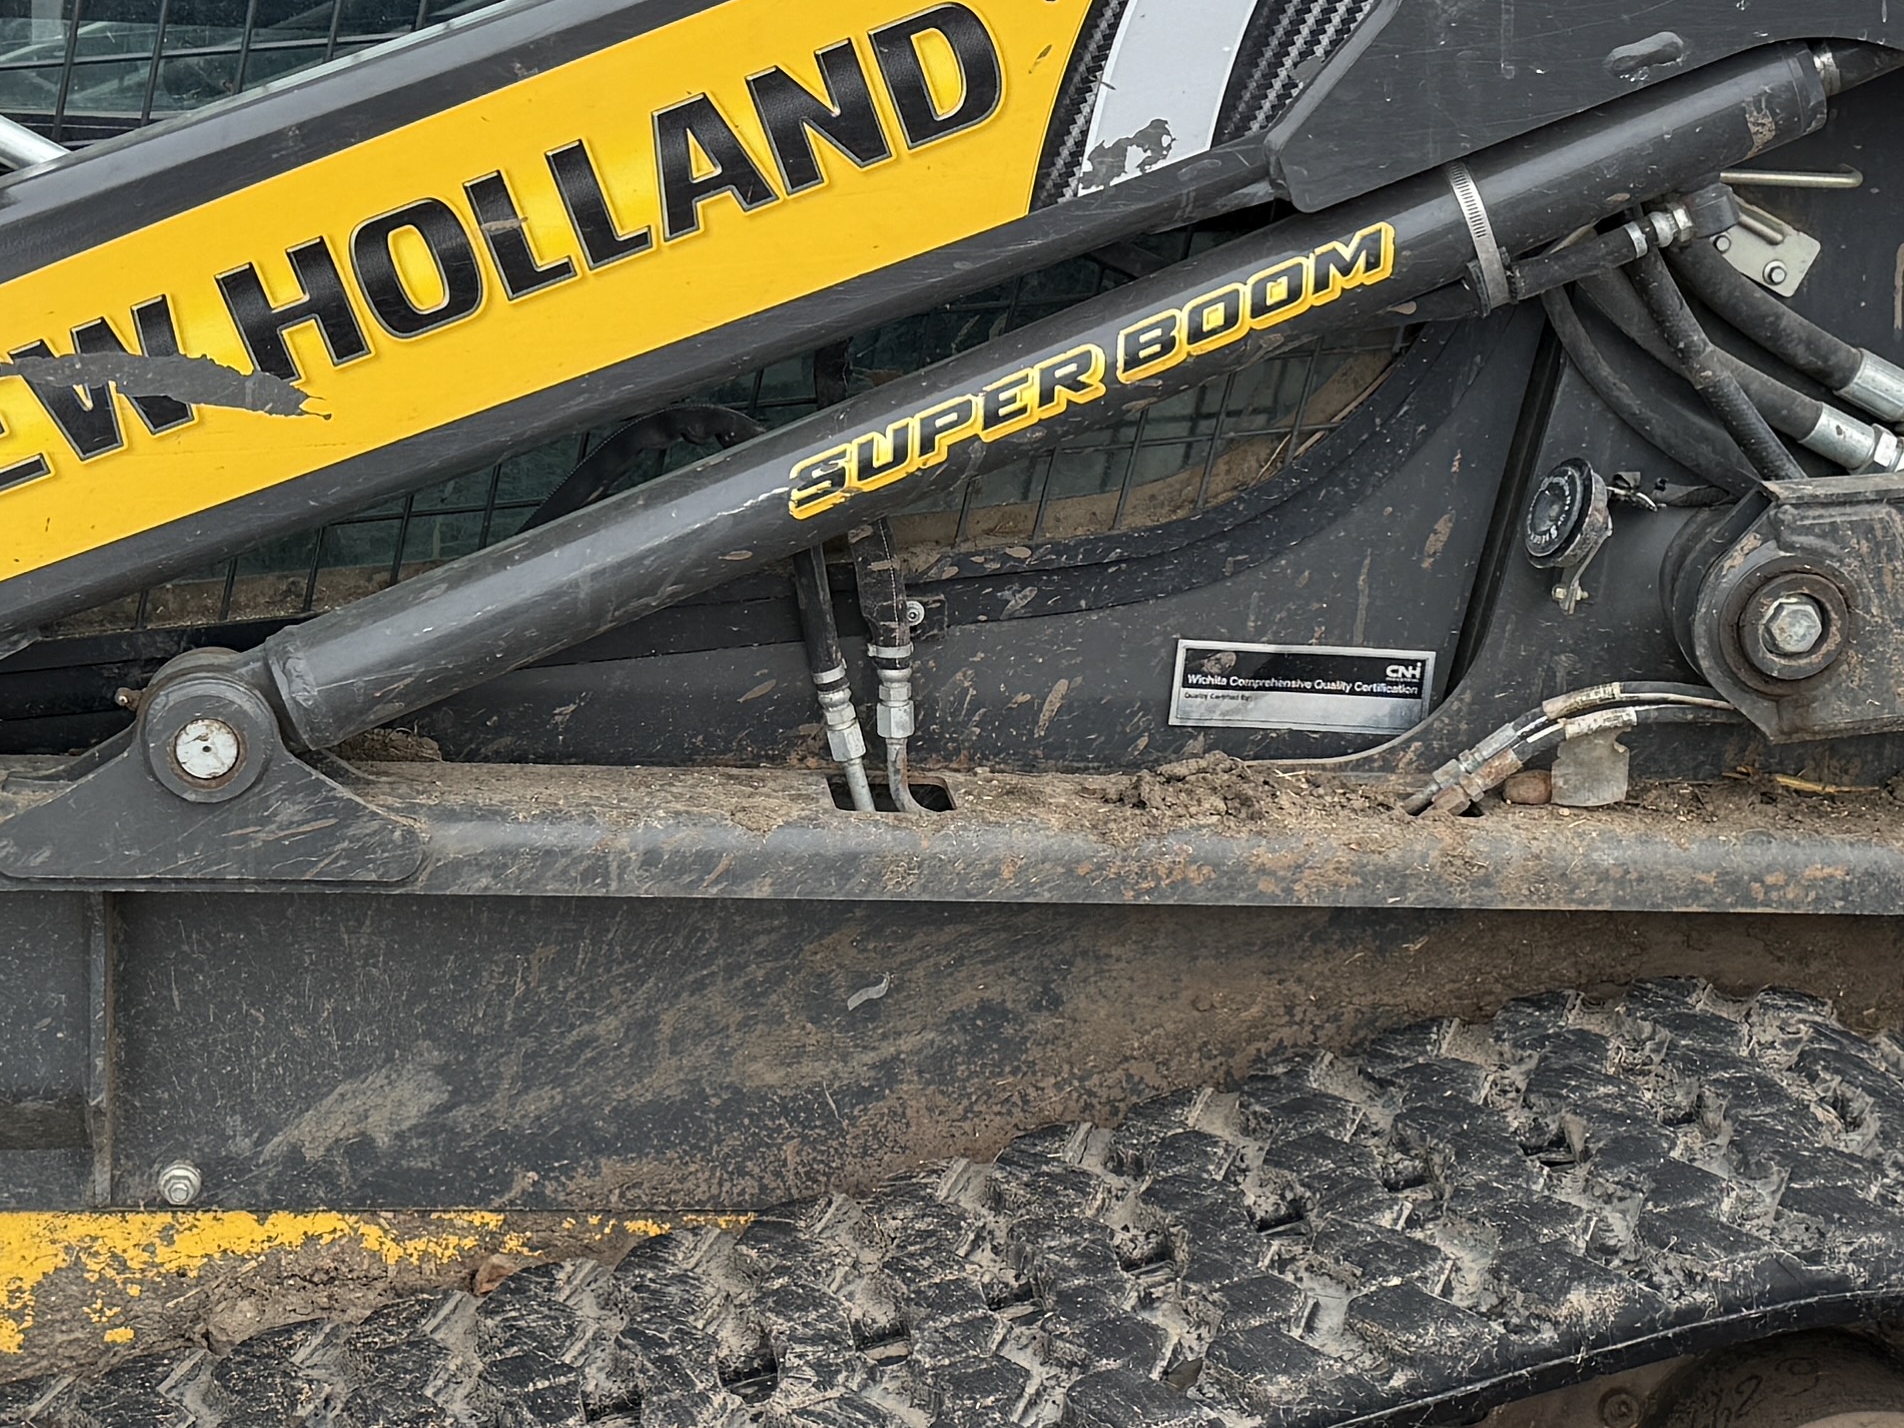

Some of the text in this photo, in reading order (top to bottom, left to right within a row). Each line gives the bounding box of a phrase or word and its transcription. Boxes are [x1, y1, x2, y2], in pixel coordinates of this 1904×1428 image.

[214, 0, 1004, 382] HOLLAND
[788, 221, 1396, 522] SUPER BOOM
[1187, 673, 1418, 695] Wichita Comprehensive Quality Certification
